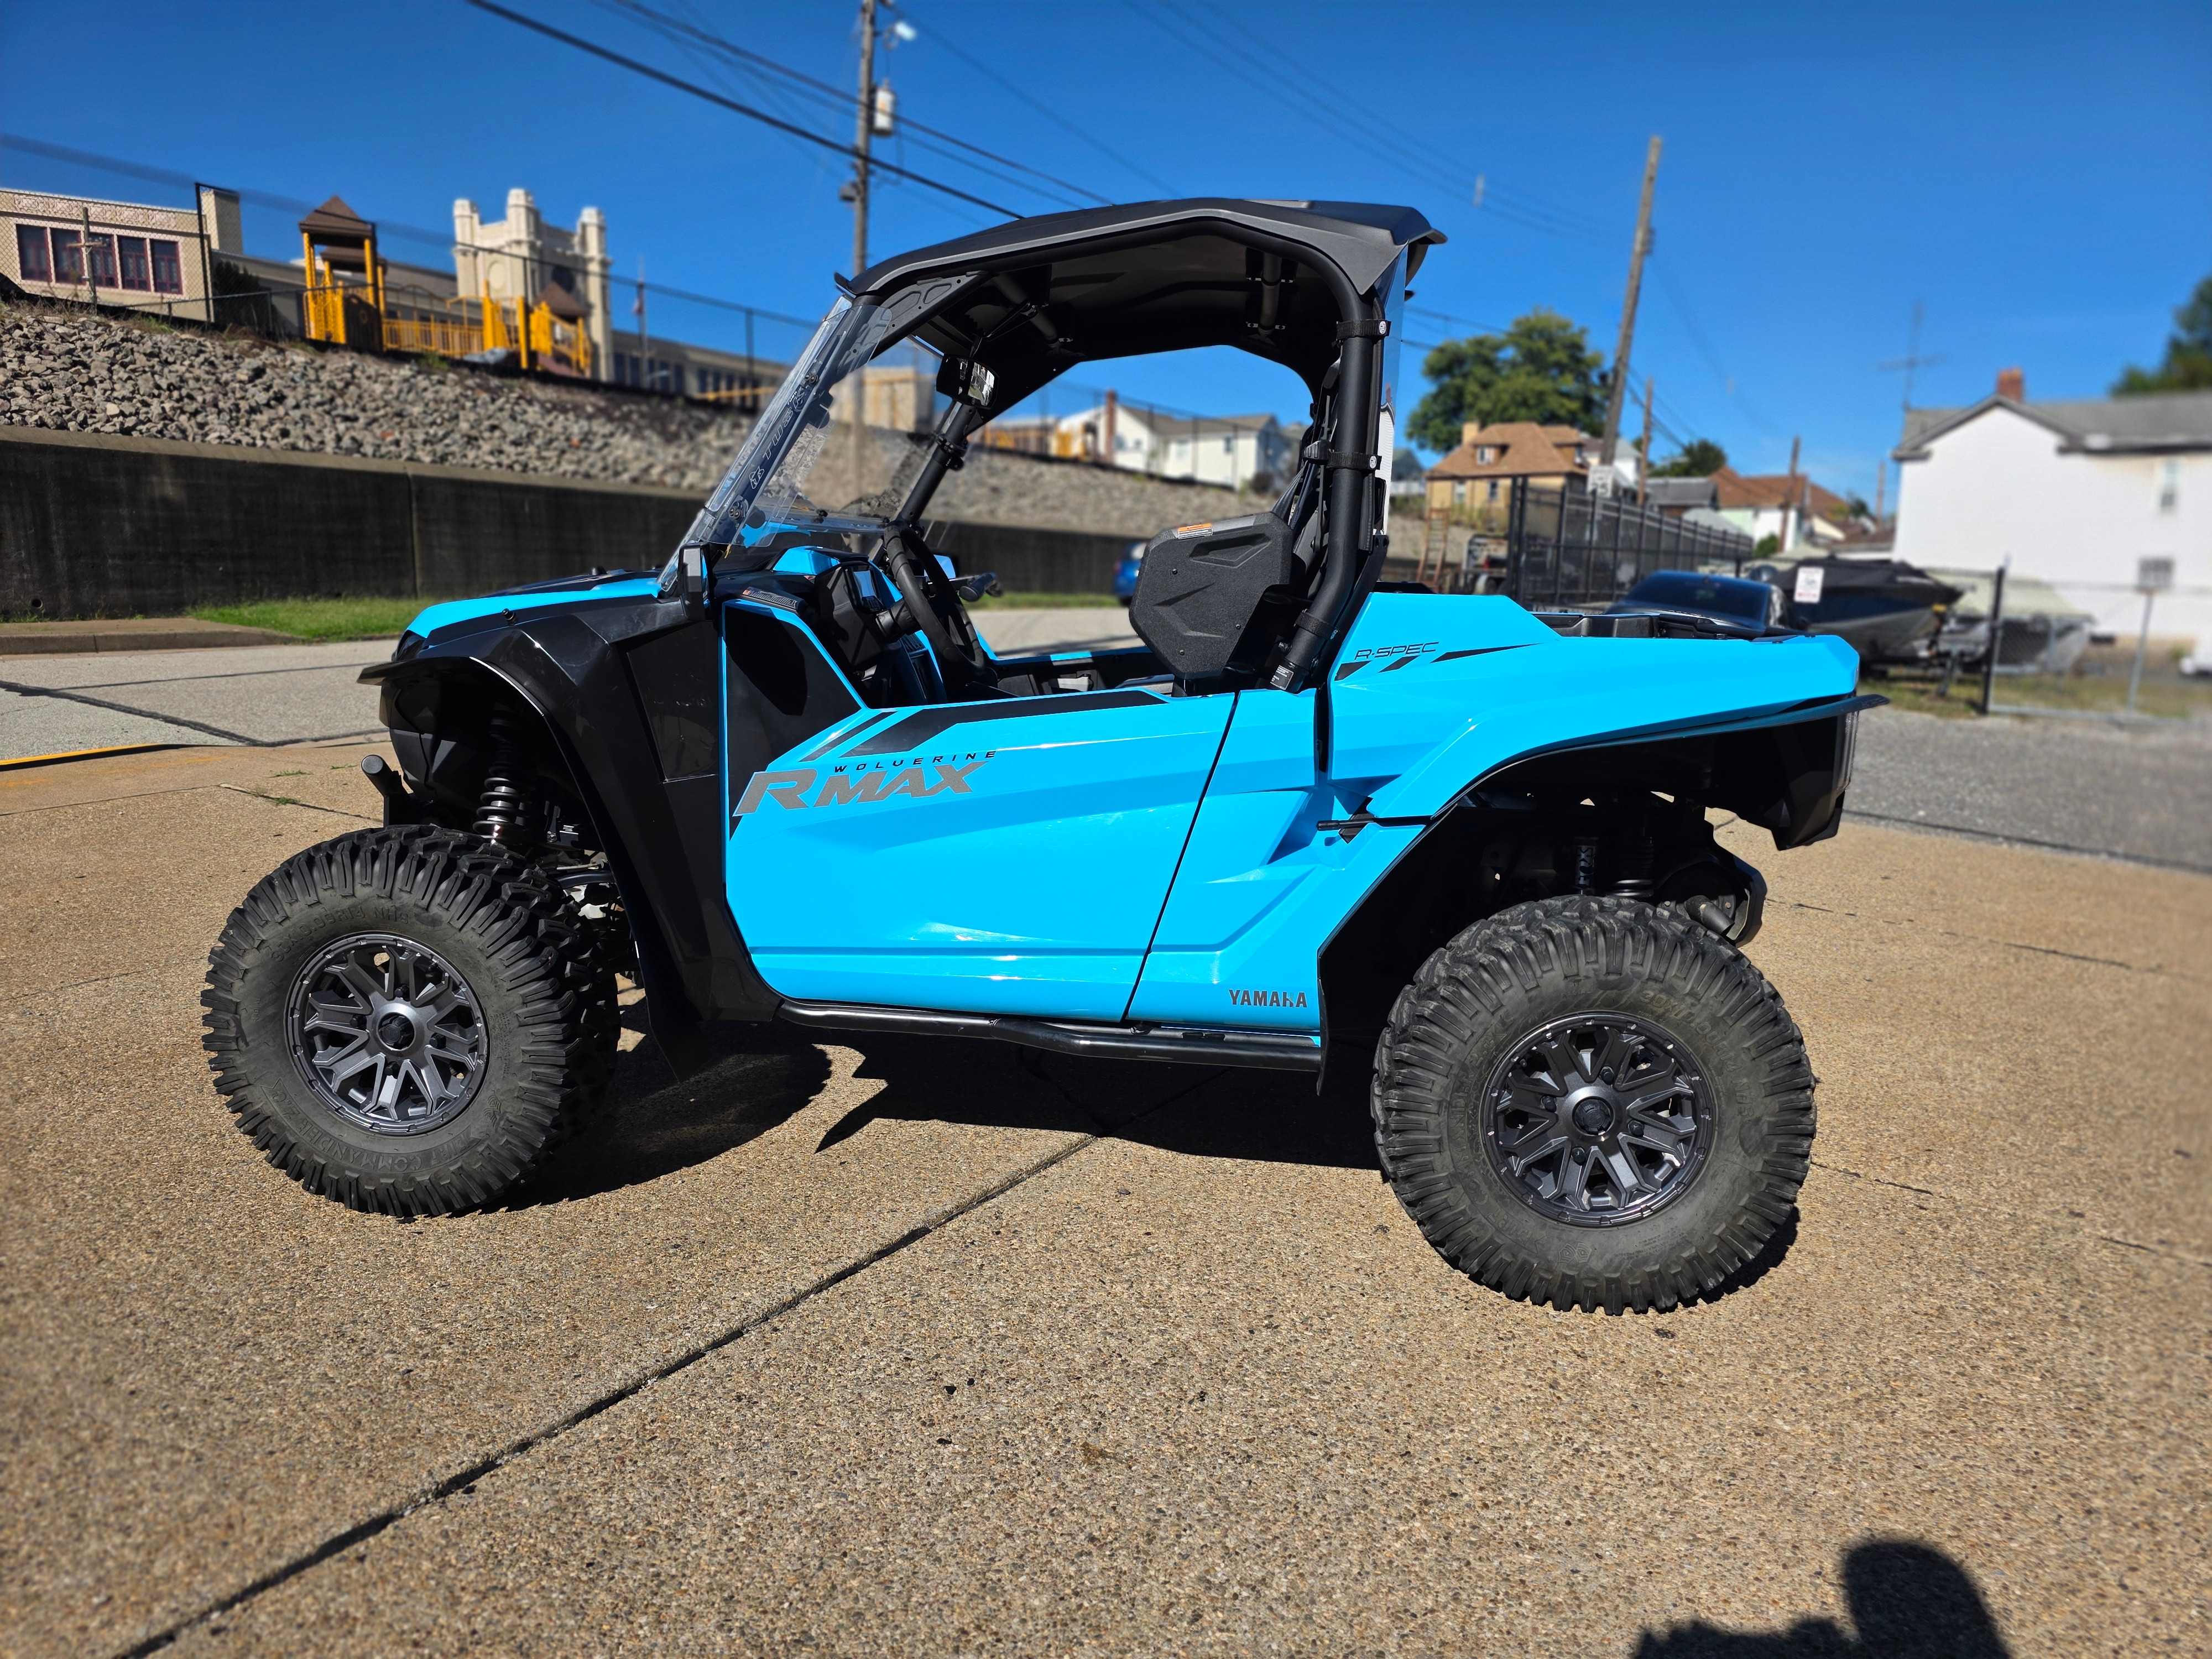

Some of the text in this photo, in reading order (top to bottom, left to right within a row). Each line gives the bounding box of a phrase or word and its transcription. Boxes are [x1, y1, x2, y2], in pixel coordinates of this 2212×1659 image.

[763, 388, 805, 461] TUSK
[834, 750, 997, 773] WOLVERINE
[271, 906, 366, 962] 30X0.00R14
[1228, 989, 1308, 1008] YAMAHA
[1640, 989, 1742, 1073] 30X10.00R14
[298, 1118, 422, 1173] COMMANDER
